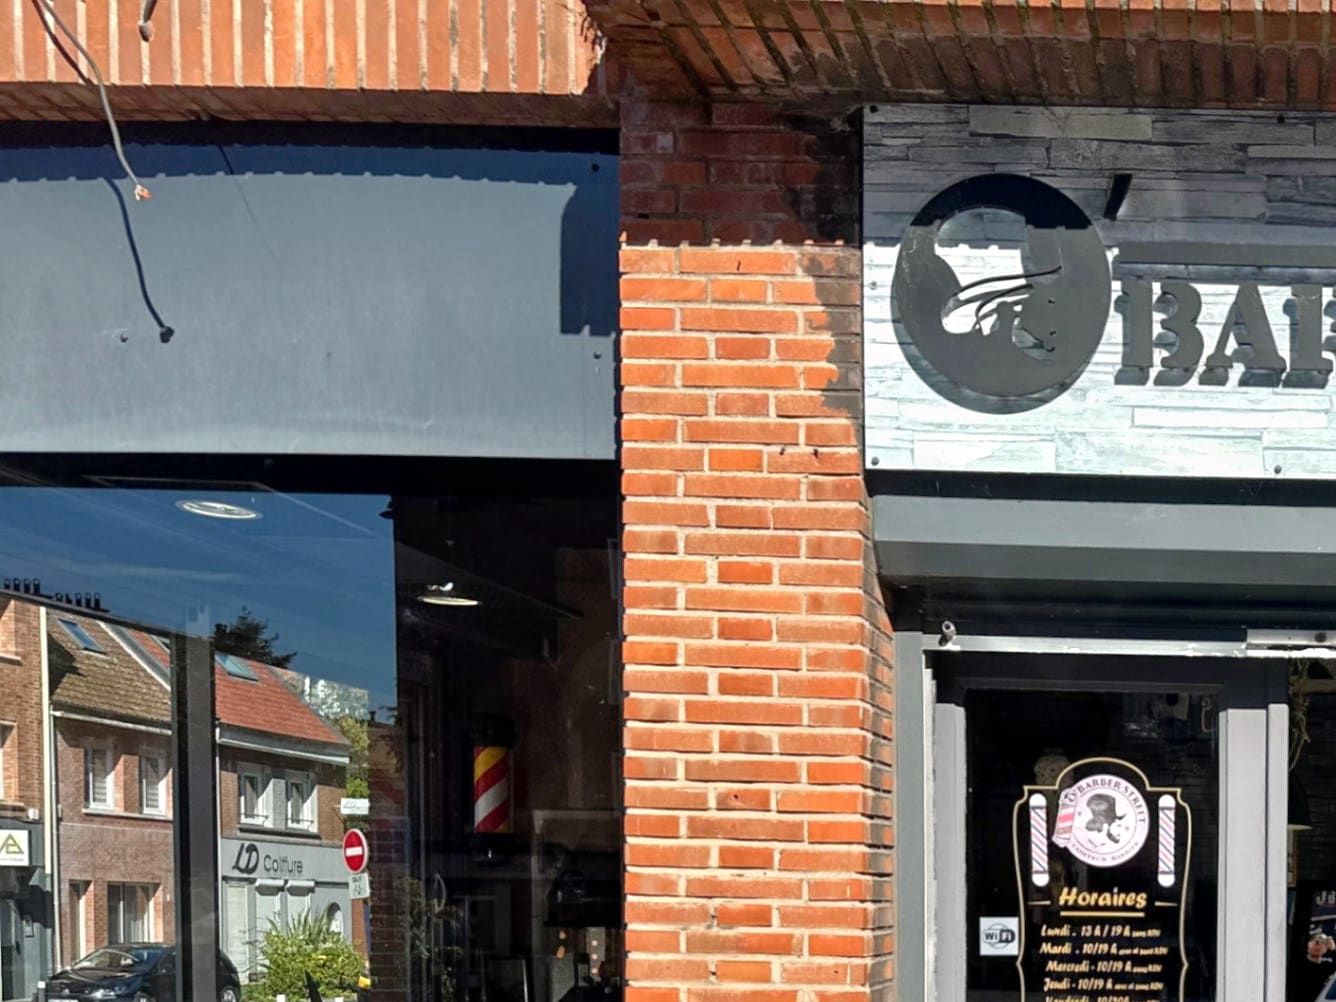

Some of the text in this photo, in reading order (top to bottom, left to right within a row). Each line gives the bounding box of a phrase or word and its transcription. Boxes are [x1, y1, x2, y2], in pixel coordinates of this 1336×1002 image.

[263, 854, 304, 874] Coiffure
[1058, 886, 1148, 909] Horaires
[1041, 924, 1071, 937] Lundi
[1040, 942, 1072, 955] Mardi
[1045, 960, 1089, 973] Mercredi
[1043, 977, 1071, 992] Jeudi
